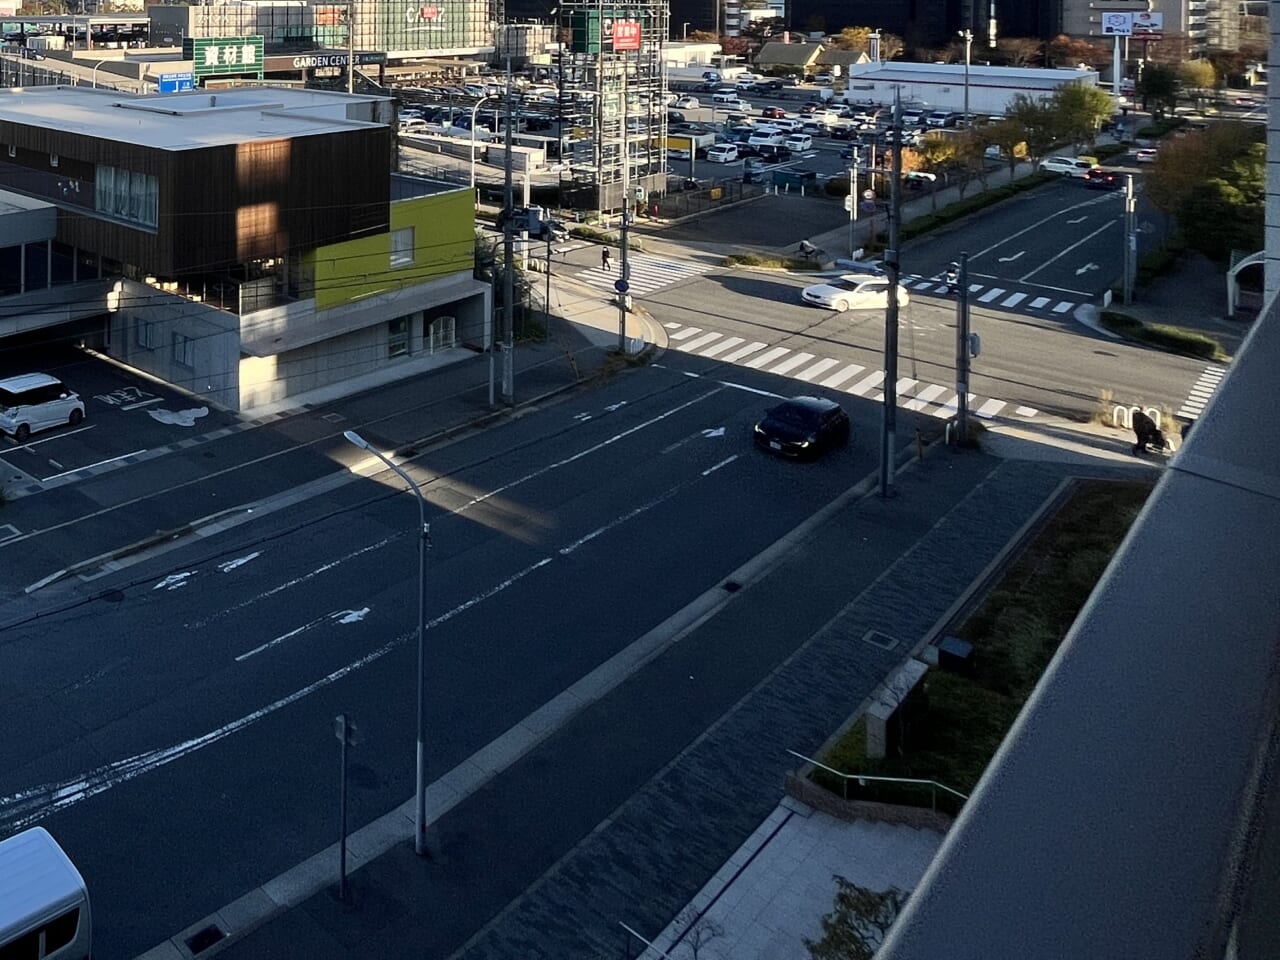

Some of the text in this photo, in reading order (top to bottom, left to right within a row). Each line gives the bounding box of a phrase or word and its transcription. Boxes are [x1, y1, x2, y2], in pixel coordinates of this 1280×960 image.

[204, 44, 256, 66] 資材館
[293, 56, 328, 68] GARDEN
